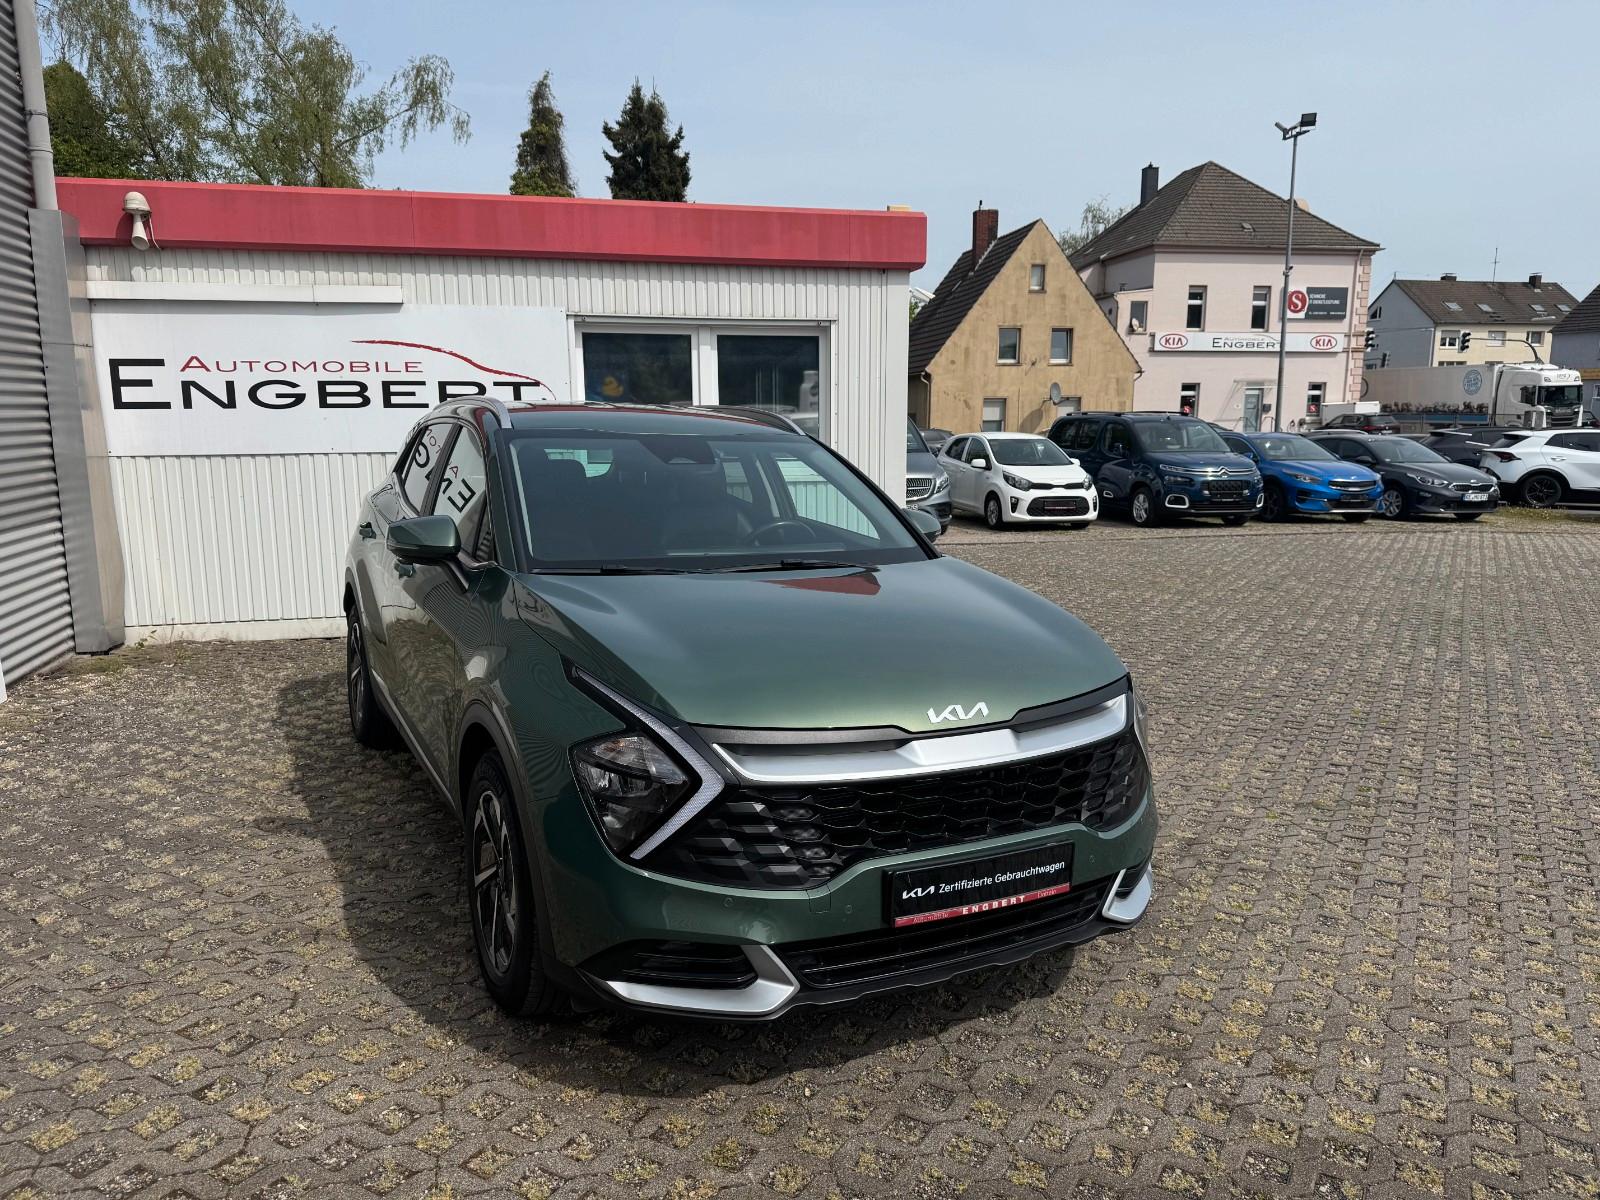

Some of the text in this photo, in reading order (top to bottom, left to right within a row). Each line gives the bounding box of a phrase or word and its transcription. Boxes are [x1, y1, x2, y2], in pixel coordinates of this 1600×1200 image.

[1164, 337, 1184, 346] KIA
[1212, 337, 1281, 349] ENGBER
[1314, 337, 1331, 347] KIA
[179, 355, 424, 373] AUTOMOBILE
[108, 358, 541, 410] ENGBERT
[926, 701, 990, 724] KIA
[901, 861, 1066, 900] KIA Zertifizierte Gebrauchtwagen
[962, 895, 1026, 915] ENGBERT
